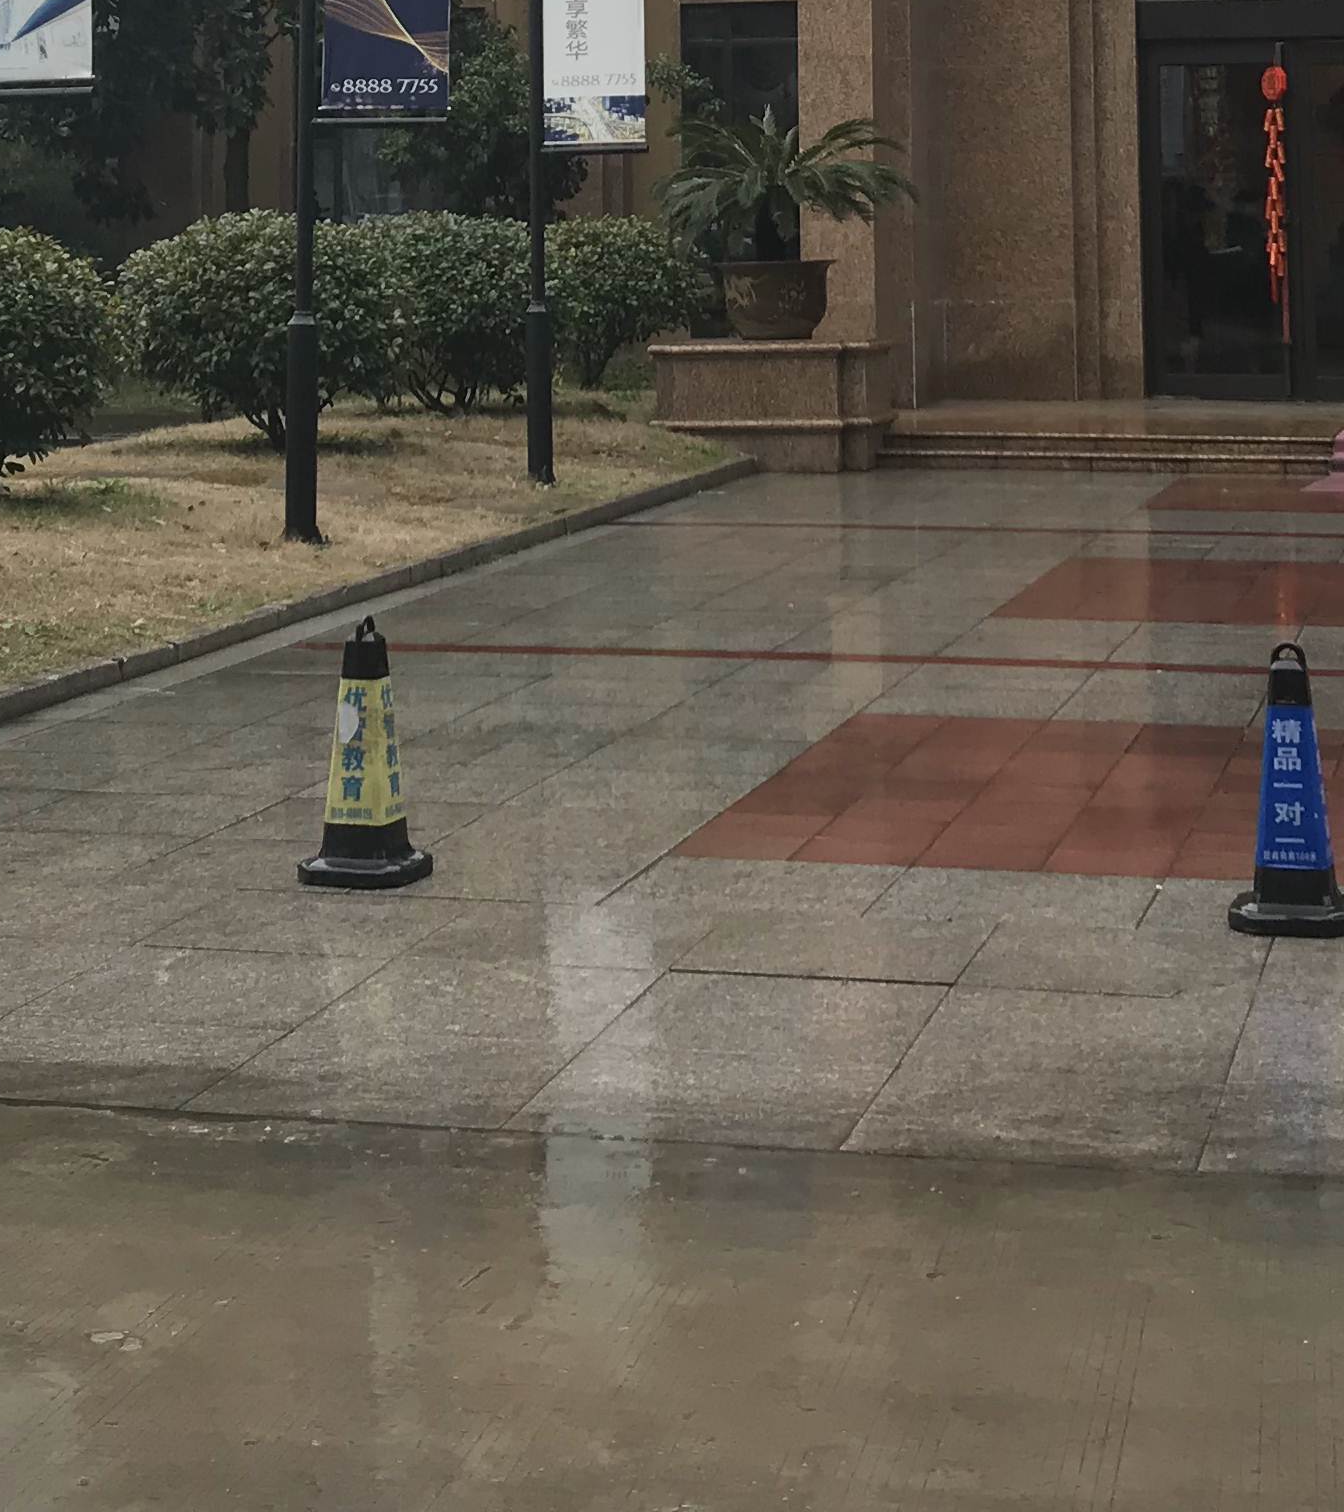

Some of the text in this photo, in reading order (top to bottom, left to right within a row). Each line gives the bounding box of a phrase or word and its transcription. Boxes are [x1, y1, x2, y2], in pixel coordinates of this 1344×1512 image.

[342, 78, 439, 94] 8888 7755
[560, 73, 637, 87] 8888 7755
[1272, 718, 1306, 844] 精品一对一
